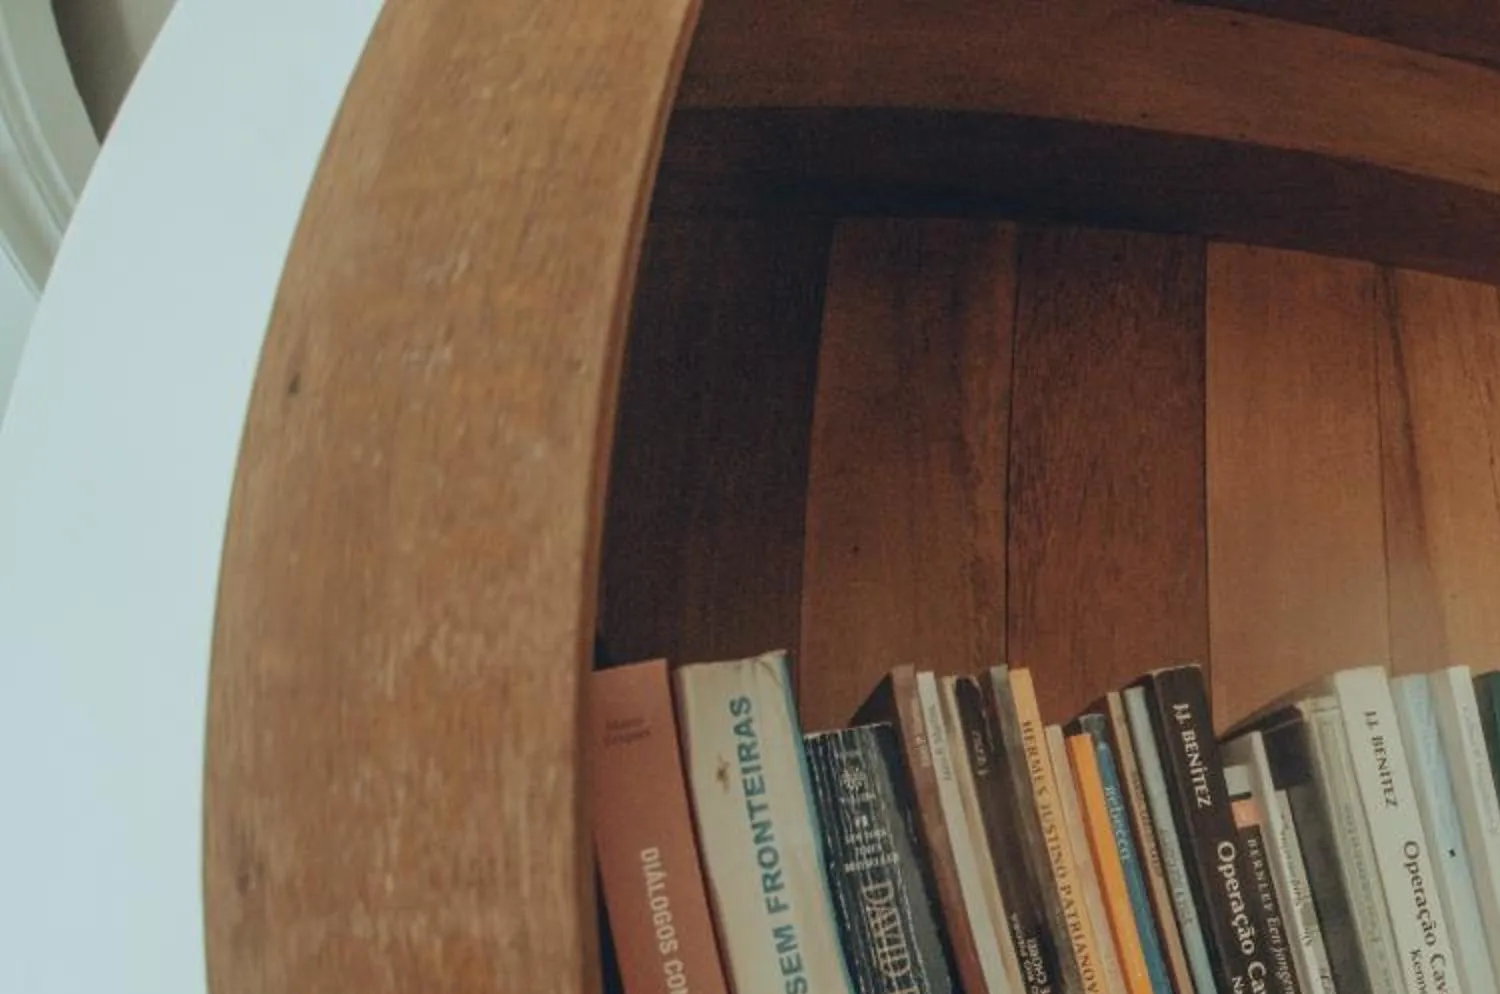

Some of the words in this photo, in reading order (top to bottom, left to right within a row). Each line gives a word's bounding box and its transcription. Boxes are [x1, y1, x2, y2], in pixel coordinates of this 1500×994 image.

[729, 696, 791, 915] FRONTEIRAS
[1040, 801, 1067, 882] JUSTINO
[641, 848, 678, 955] DIÁLOGOS
[861, 881, 911, 978] DAVID
[1216, 841, 1256, 955] Operação
[1403, 840, 1436, 946] Operação
